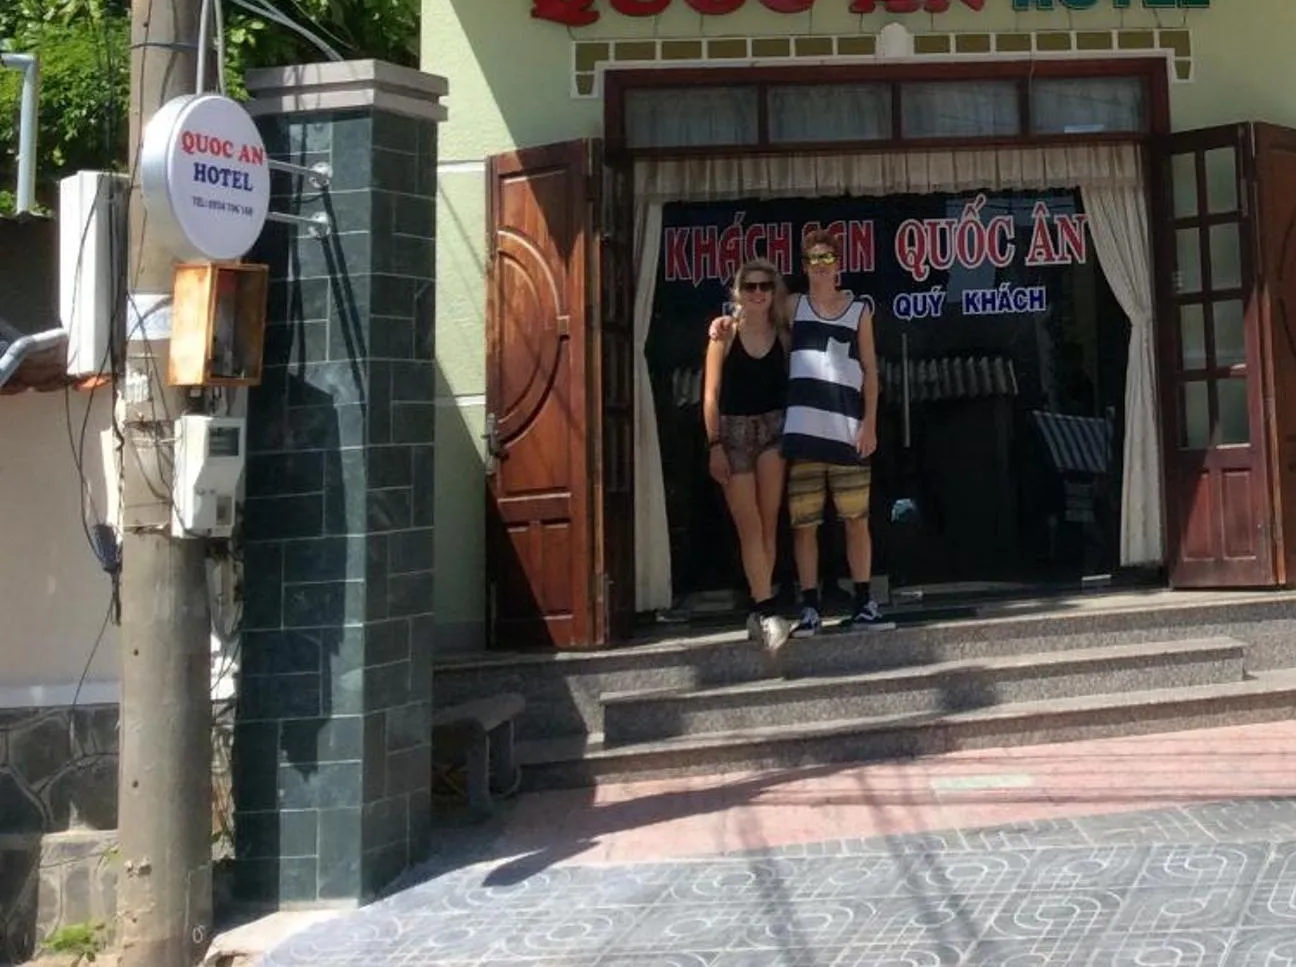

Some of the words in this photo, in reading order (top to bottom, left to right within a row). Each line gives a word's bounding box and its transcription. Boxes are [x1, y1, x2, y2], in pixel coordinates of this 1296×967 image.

[182, 130, 234, 158] QUOC
[238, 144, 264, 166] AN
[193, 162, 254, 192] HOTEL
[894, 193, 1016, 282] QUỐC
[893, 285, 947, 321] QUÝ
[962, 282, 1047, 316] KHÁCH
